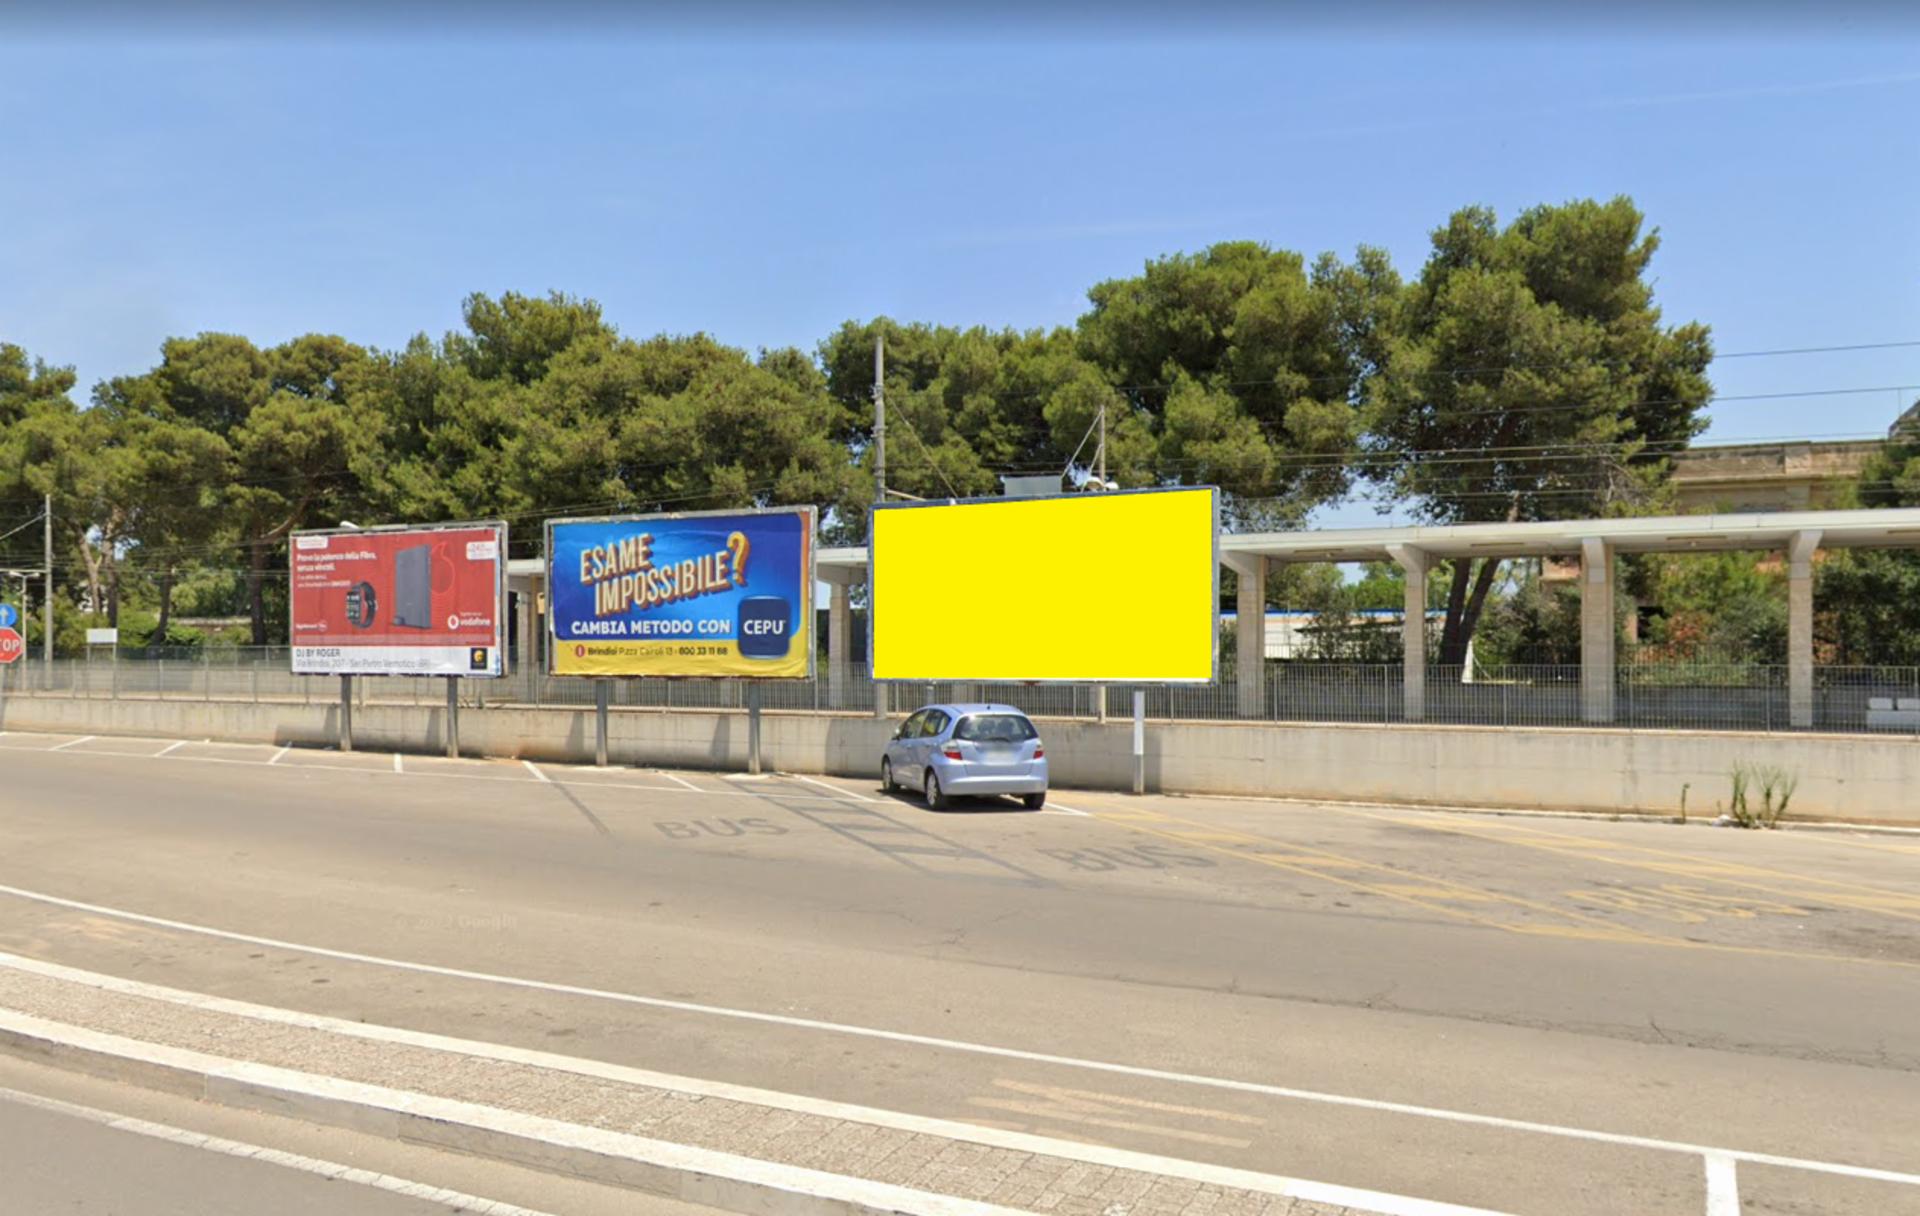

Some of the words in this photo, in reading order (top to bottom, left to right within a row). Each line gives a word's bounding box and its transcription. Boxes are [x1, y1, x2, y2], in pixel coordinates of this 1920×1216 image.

[580, 533, 654, 585] ESAME
[595, 531, 750, 616] IMPOSSIBILE?
[571, 621, 627, 635] CAMBIA
[630, 620, 693, 635] METODO
[698, 619, 730, 634] CON
[743, 619, 785, 635] CEPU
[306, 649, 315, 657] BY
[653, 818, 790, 840] BUS
[1033, 845, 1218, 872] BUS
